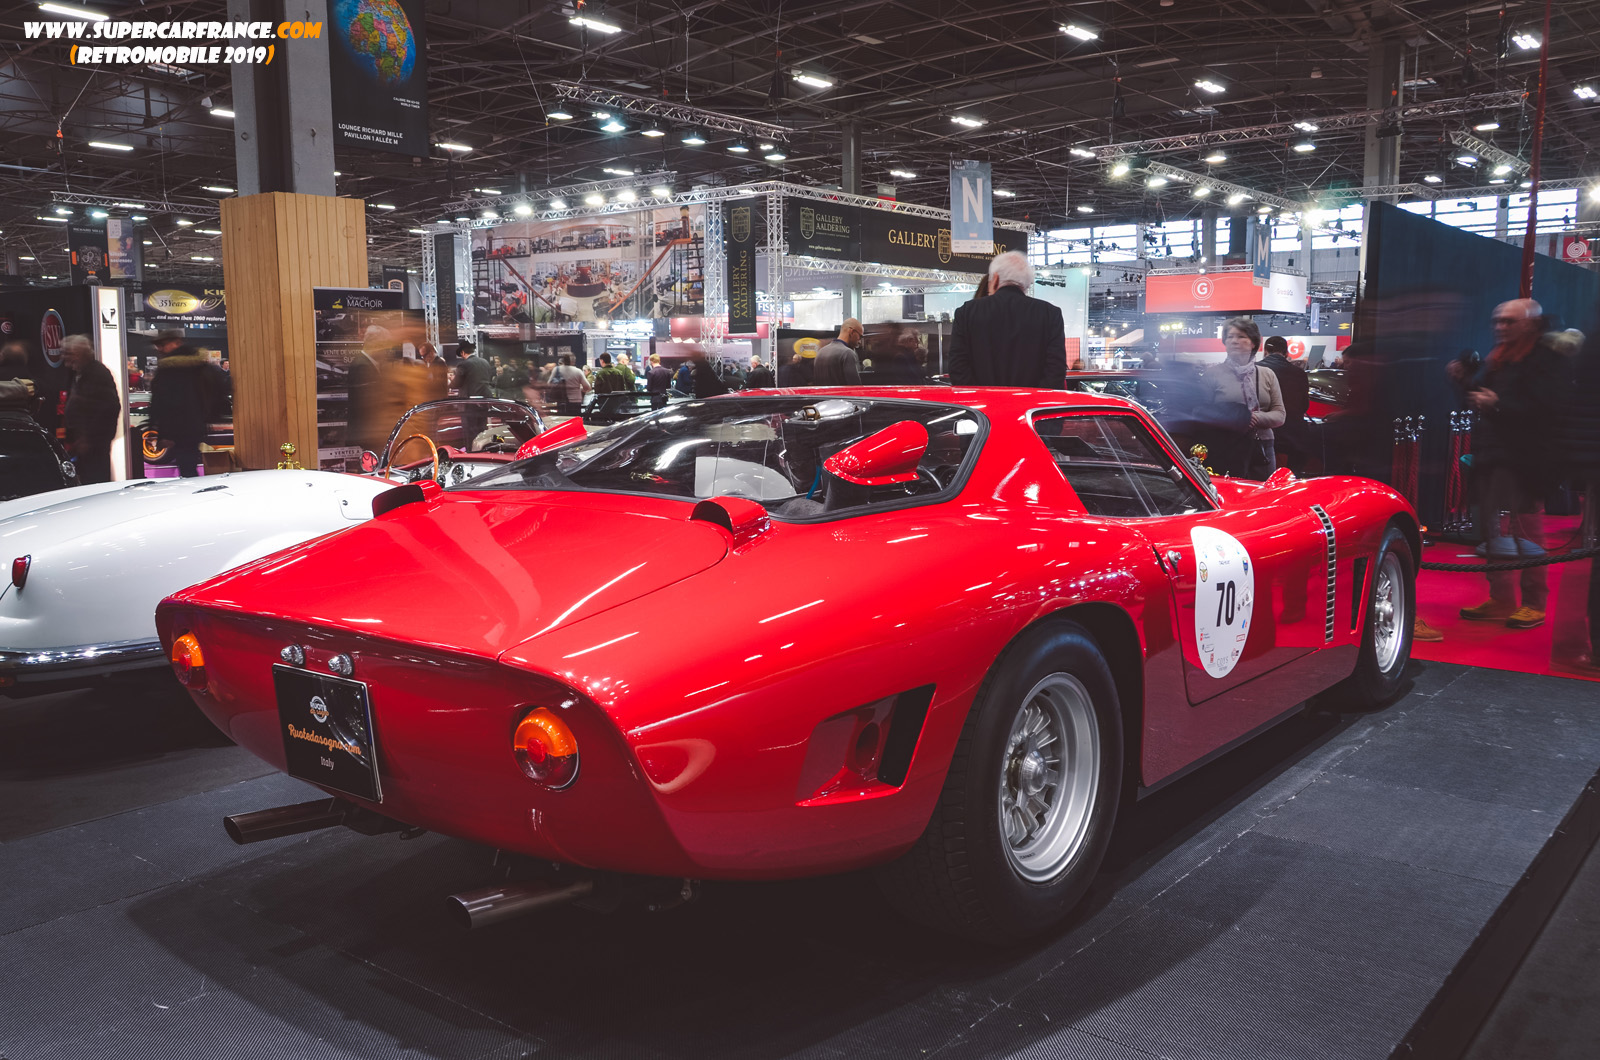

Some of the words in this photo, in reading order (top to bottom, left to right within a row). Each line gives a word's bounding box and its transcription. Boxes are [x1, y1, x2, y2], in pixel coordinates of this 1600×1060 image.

[338, 123, 361, 132] LOUNGE
[361, 126, 387, 136] RICHARD
[387, 130, 404, 139] MILLE
[344, 131, 371, 141] PAVILLON
[375, 136, 393, 145] ALLÉE
[962, 177, 984, 223] N
[816, 214, 843, 225] GALLERY
[815, 222, 850, 234] AALDERING
[888, 229, 937, 249] GALLERY
[1257, 234, 1269, 268] M
[740, 249, 748, 318] AALDERING
[1196, 282, 1209, 295] G
[732, 265, 741, 319] GALLERY
[159, 299, 168, 308] 35
[168, 299, 188, 308] Years
[1289, 343, 1299, 355] G
[1216, 580, 1236, 628] 70
[287, 723, 362, 755] Ruotedasogno.com
[320, 756, 335, 771] Italy
